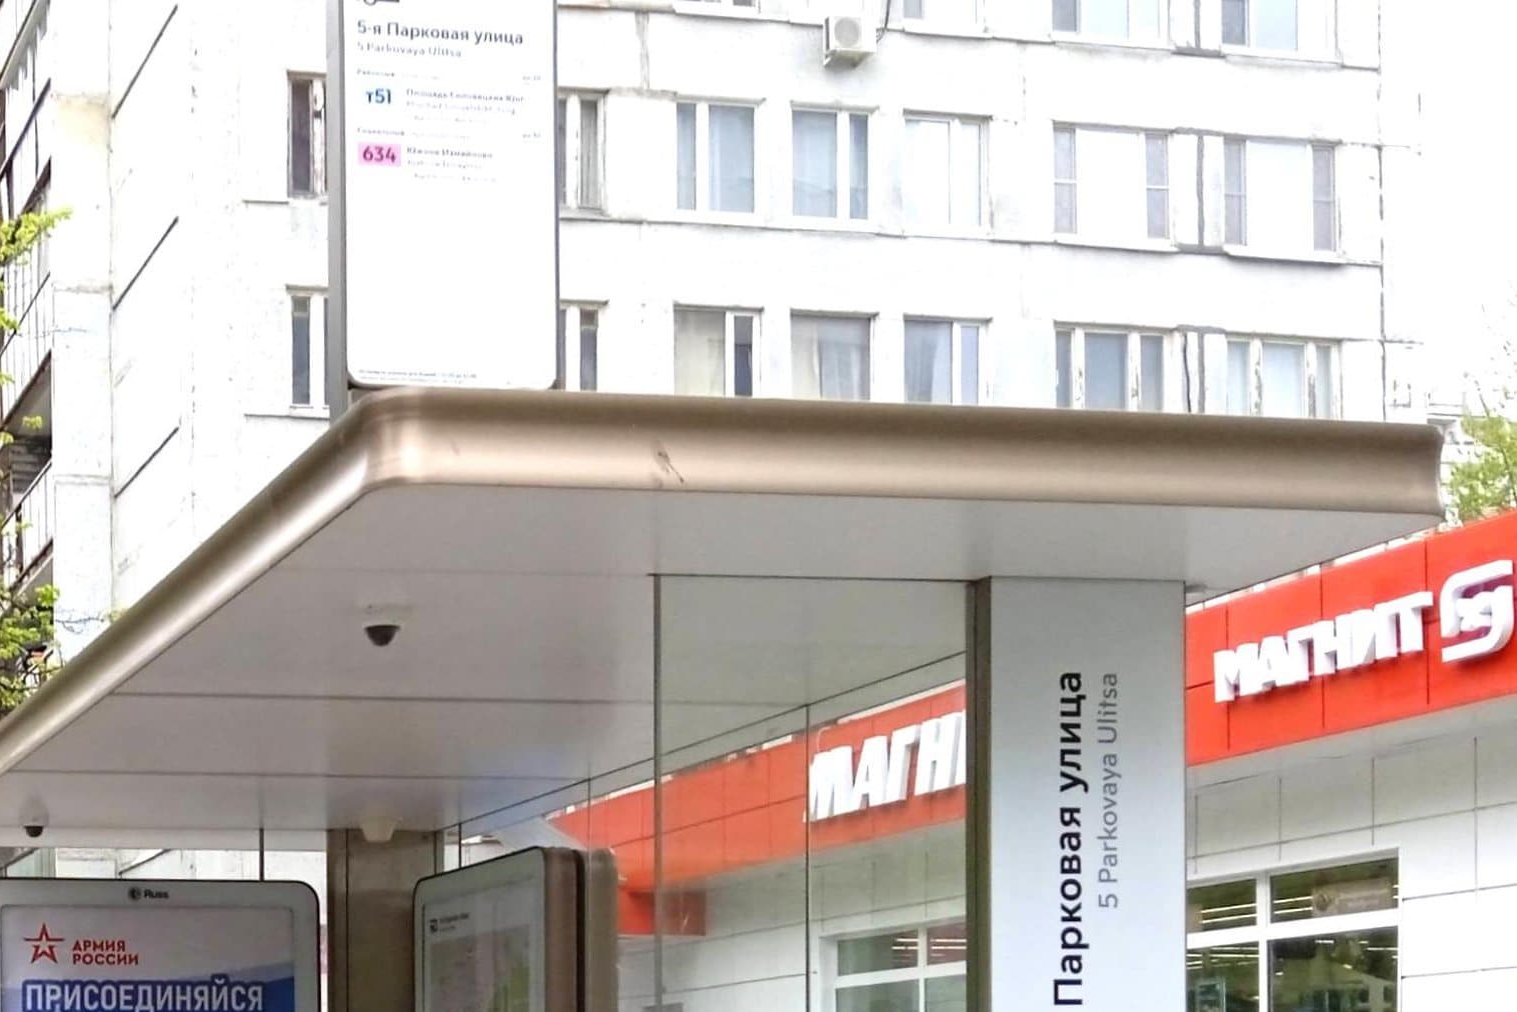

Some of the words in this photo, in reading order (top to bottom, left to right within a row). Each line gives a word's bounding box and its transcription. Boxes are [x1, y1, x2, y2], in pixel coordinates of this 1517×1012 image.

[357, 19, 382, 35] 5-я
[387, 22, 470, 41] Парковая
[474, 30, 524, 46] улица
[362, 145, 396, 163] 634
[1213, 591, 1434, 703] МАГНИТ
[1059, 672, 1089, 794] улица
[1096, 672, 1118, 745] Ulitsa
[803, 709, 967, 823] МАГН
[1097, 753, 1122, 884] Parkovaya
[1053, 807, 1090, 1006] Парковая
[1098, 893, 1119, 909] 5
[72, 939, 126, 952] АРМИЯ
[72, 953, 139, 966] РОССИИ
